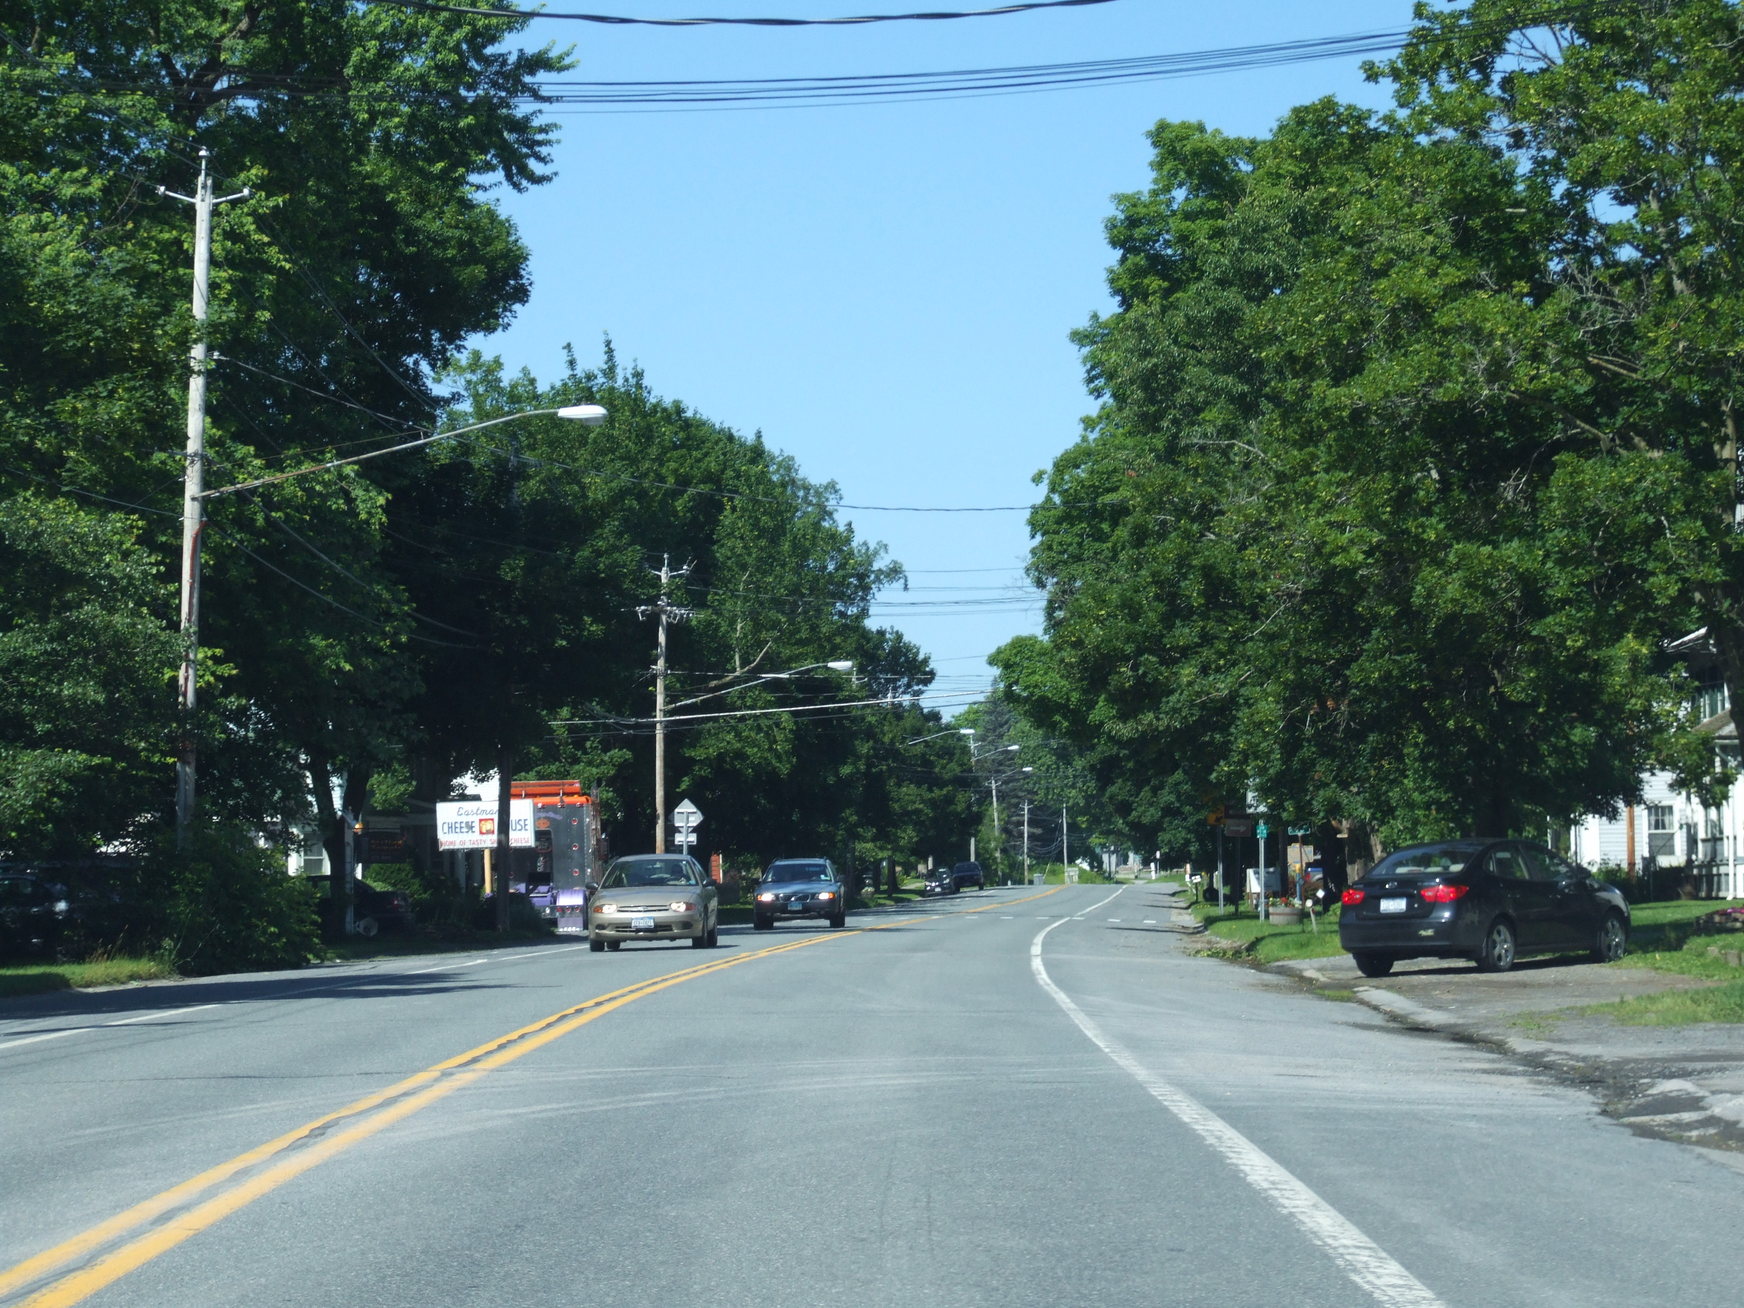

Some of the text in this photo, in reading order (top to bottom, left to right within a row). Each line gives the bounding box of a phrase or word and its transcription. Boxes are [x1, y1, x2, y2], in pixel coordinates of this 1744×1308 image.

[442, 818, 529, 834] CHEESE USE
[468, 838, 487, 846] TASTY
